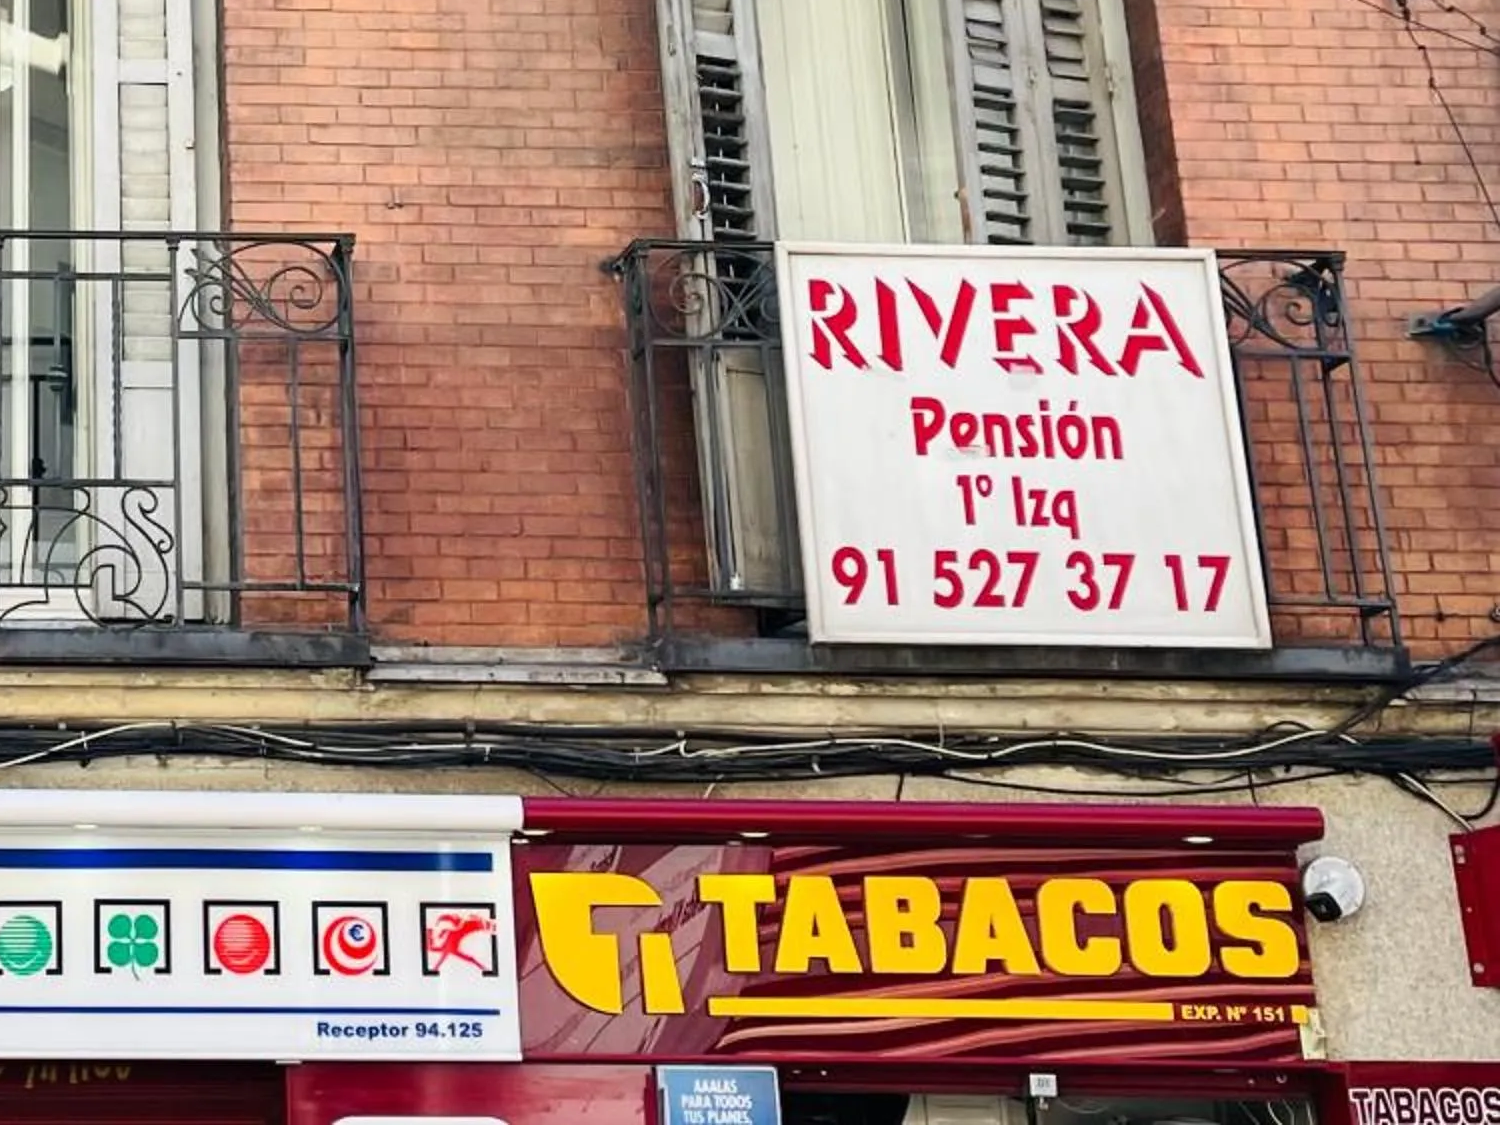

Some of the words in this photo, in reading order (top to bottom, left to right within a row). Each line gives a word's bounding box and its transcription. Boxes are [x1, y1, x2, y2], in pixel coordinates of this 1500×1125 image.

[808, 277, 1204, 379] RIVERA
[910, 395, 1124, 460] Pensión
[1011, 475, 1081, 540] Izq
[831, 546, 900, 606] 91
[933, 549, 1041, 610] 527
[1066, 551, 1136, 612] 37
[1164, 553, 1231, 613] 17
[699, 874, 1300, 979] TABACOS
[316, 1021, 409, 1040] Receptor
[414, 1022, 484, 1038] 94.125
[1181, 1005, 1221, 1020] EXP.
[1252, 1007, 1286, 1022] 151
[1348, 1087, 1500, 1125] TABACOS
